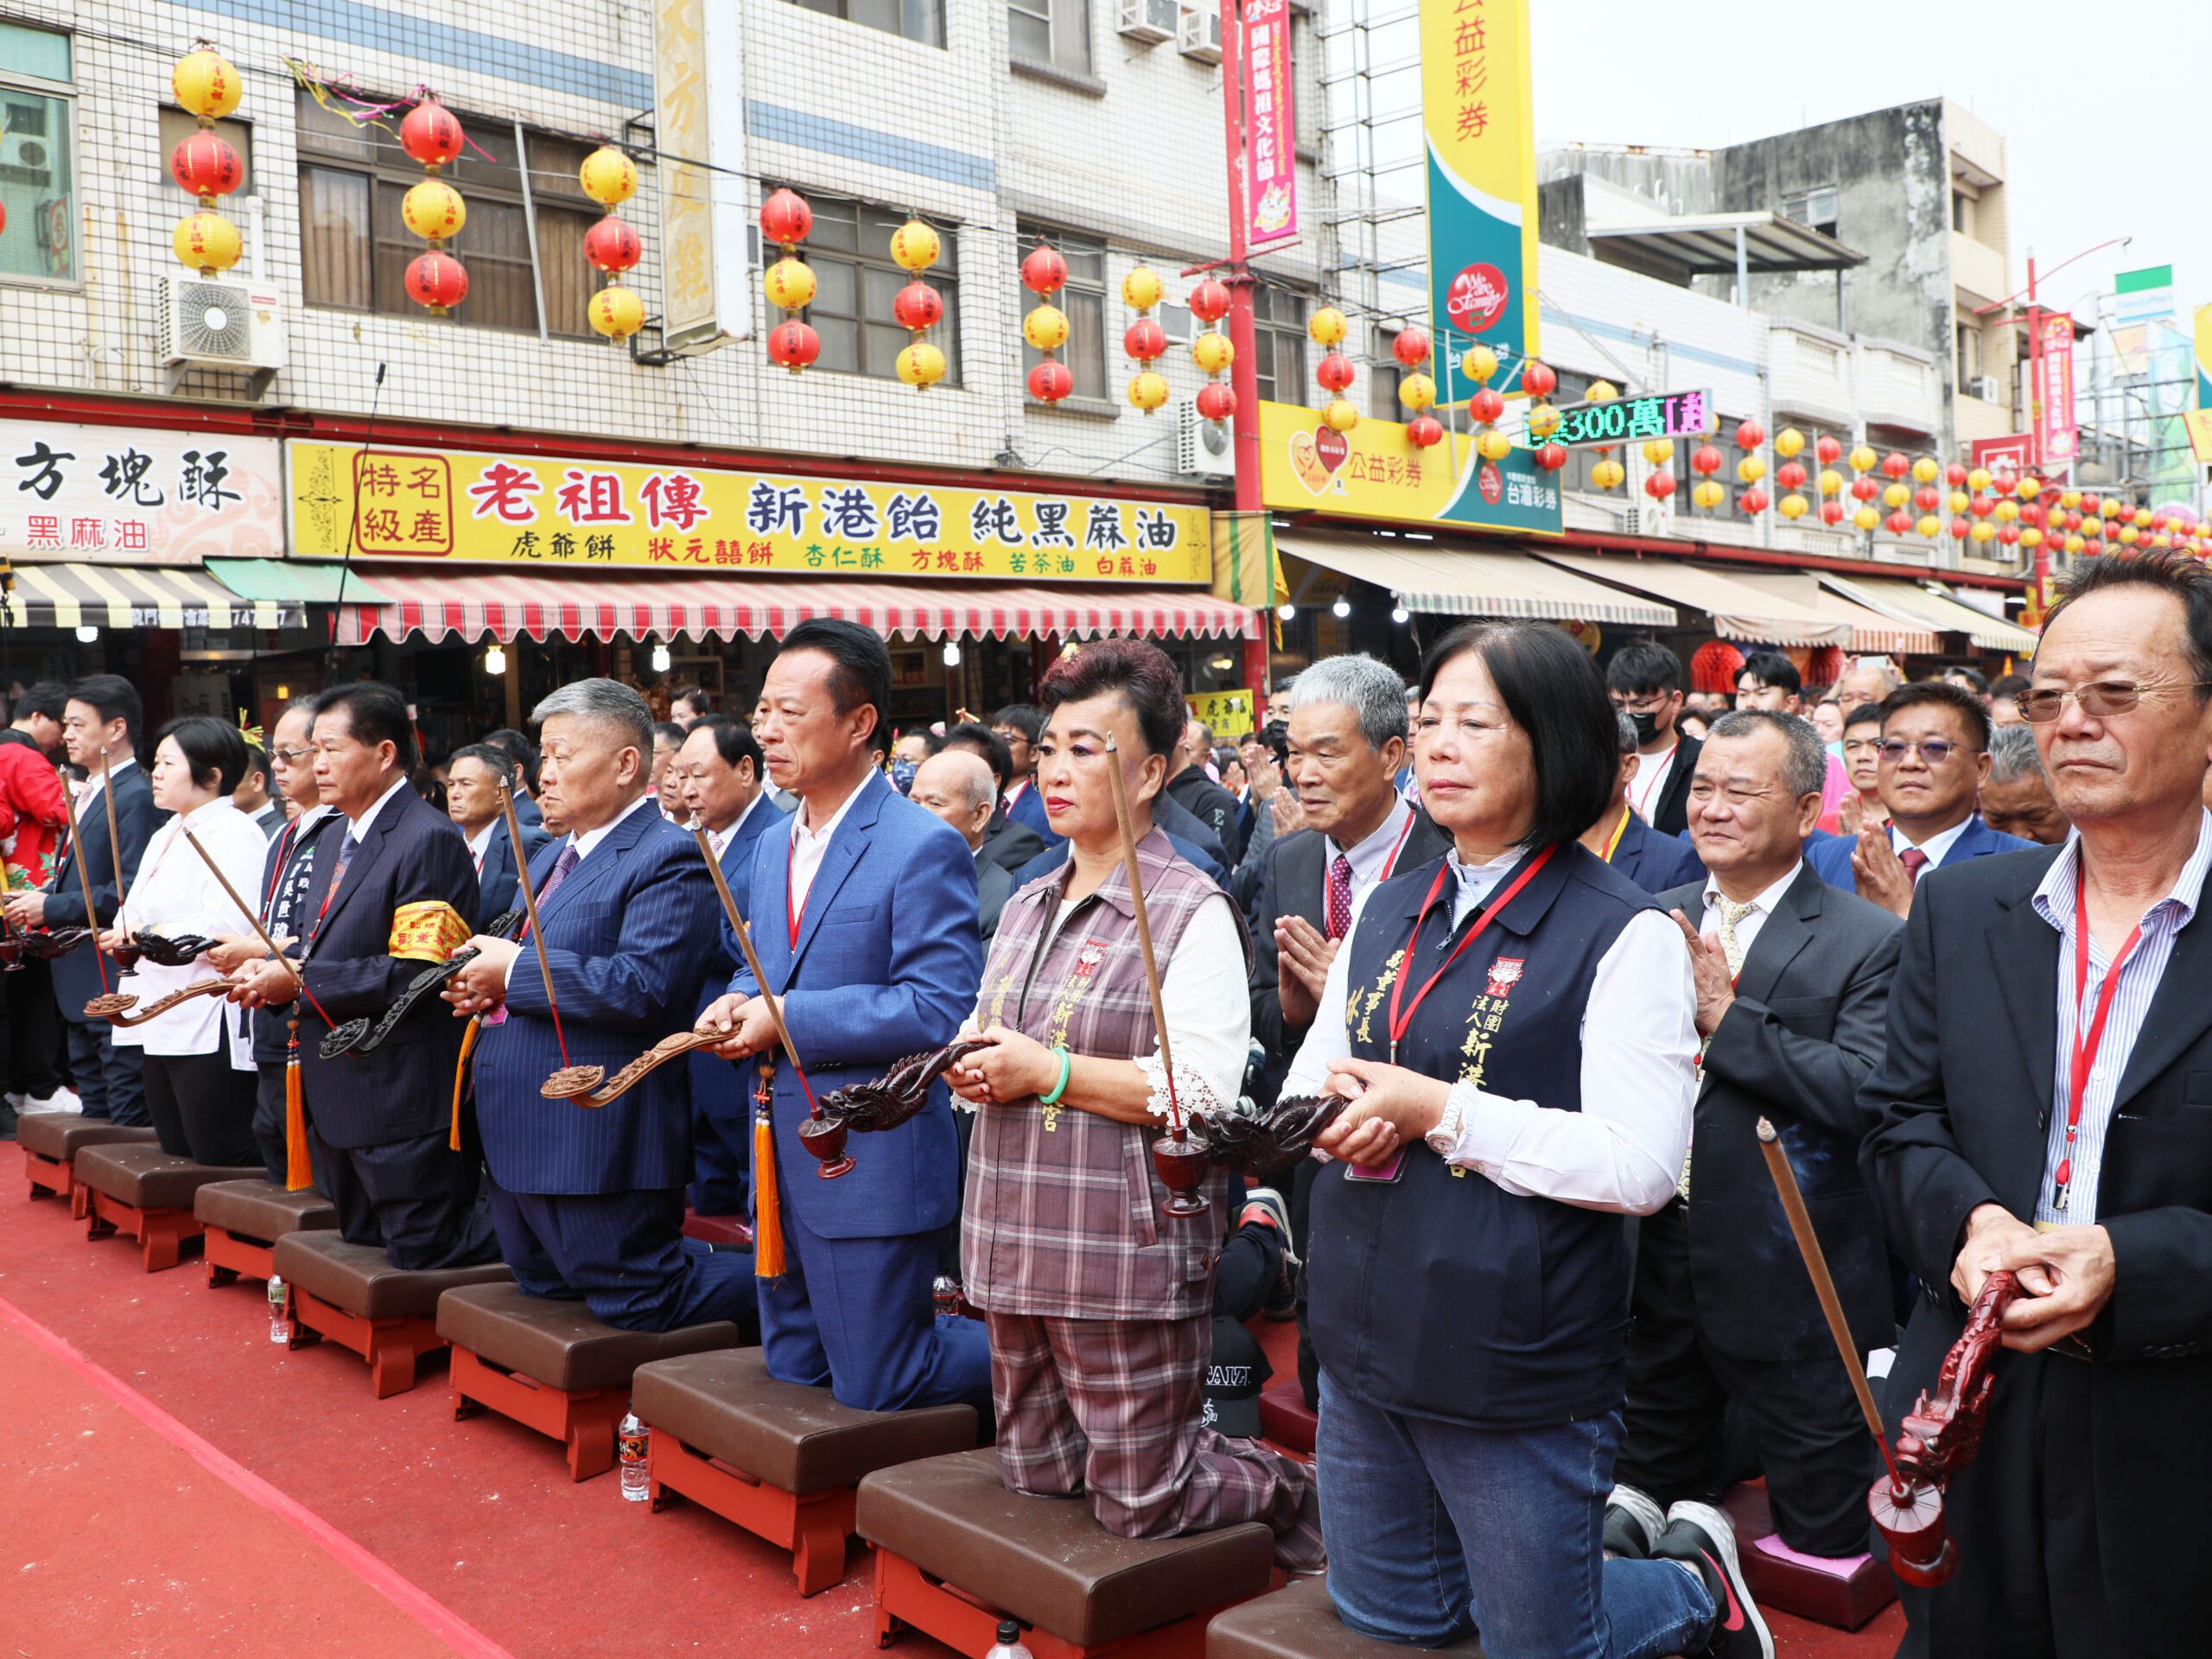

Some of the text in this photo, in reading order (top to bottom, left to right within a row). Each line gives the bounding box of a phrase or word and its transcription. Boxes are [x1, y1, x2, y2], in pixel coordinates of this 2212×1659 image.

[16, 442, 242, 511] 方塊酥
[1347, 452, 1422, 488] 公益彩券
[471, 463, 709, 531] 老祖傳
[747, 482, 942, 540] 新港飴
[1507, 481, 1557, 511] 台灣彩券
[27, 515, 149, 551] 黑麻油
[511, 531, 615, 560] 虎爺餅
[648, 537, 774, 566] 狀元囍餅
[804, 543, 884, 569] 杏仁酥
[912, 549, 985, 572] 方塊酥
[1009, 553, 1075, 574] 苦茶油
[1465, 995, 1510, 1033] 財團 法人
[1458, 1026, 1492, 1087] 新港
